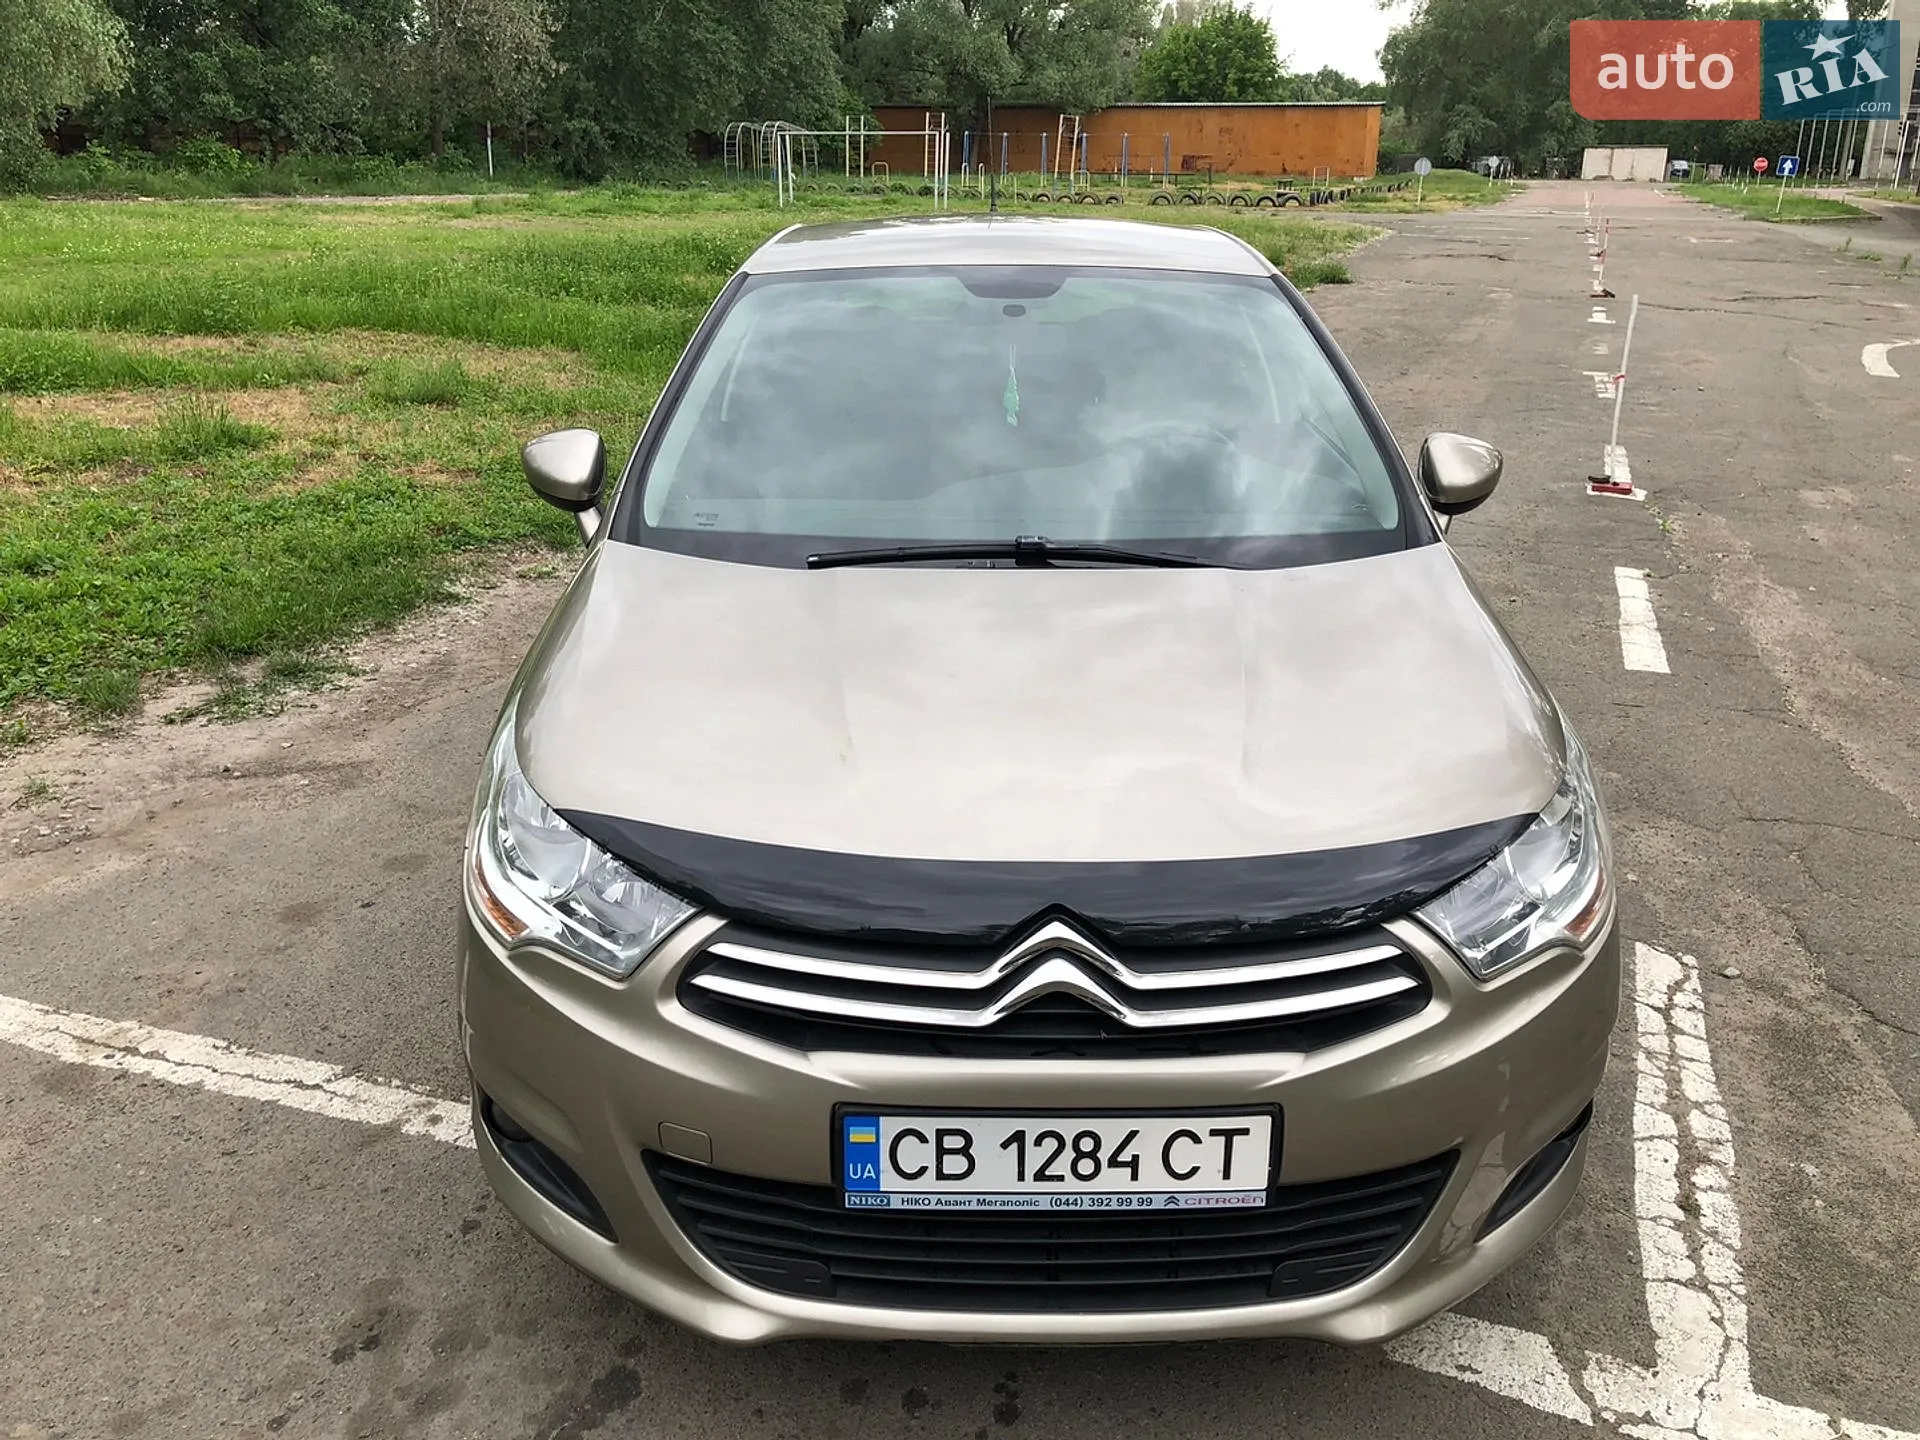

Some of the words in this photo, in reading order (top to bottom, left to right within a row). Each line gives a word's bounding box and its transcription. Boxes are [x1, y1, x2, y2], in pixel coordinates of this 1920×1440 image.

[888, 1127, 976, 1181] CB
[999, 1128, 1140, 1182] 1284
[1161, 1127, 1250, 1181] CT
[849, 1164, 876, 1179] UA
[849, 1195, 889, 1206] NIKO
[935, 1198, 973, 1207] Авант
[976, 1197, 1041, 1208] Мегаполіс
[1049, 1196, 1084, 1208] (044)
[1088, 1197, 1112, 1207] 392
[1116, 1197, 1132, 1207] 99
[1137, 1196, 1153, 1206] 99
